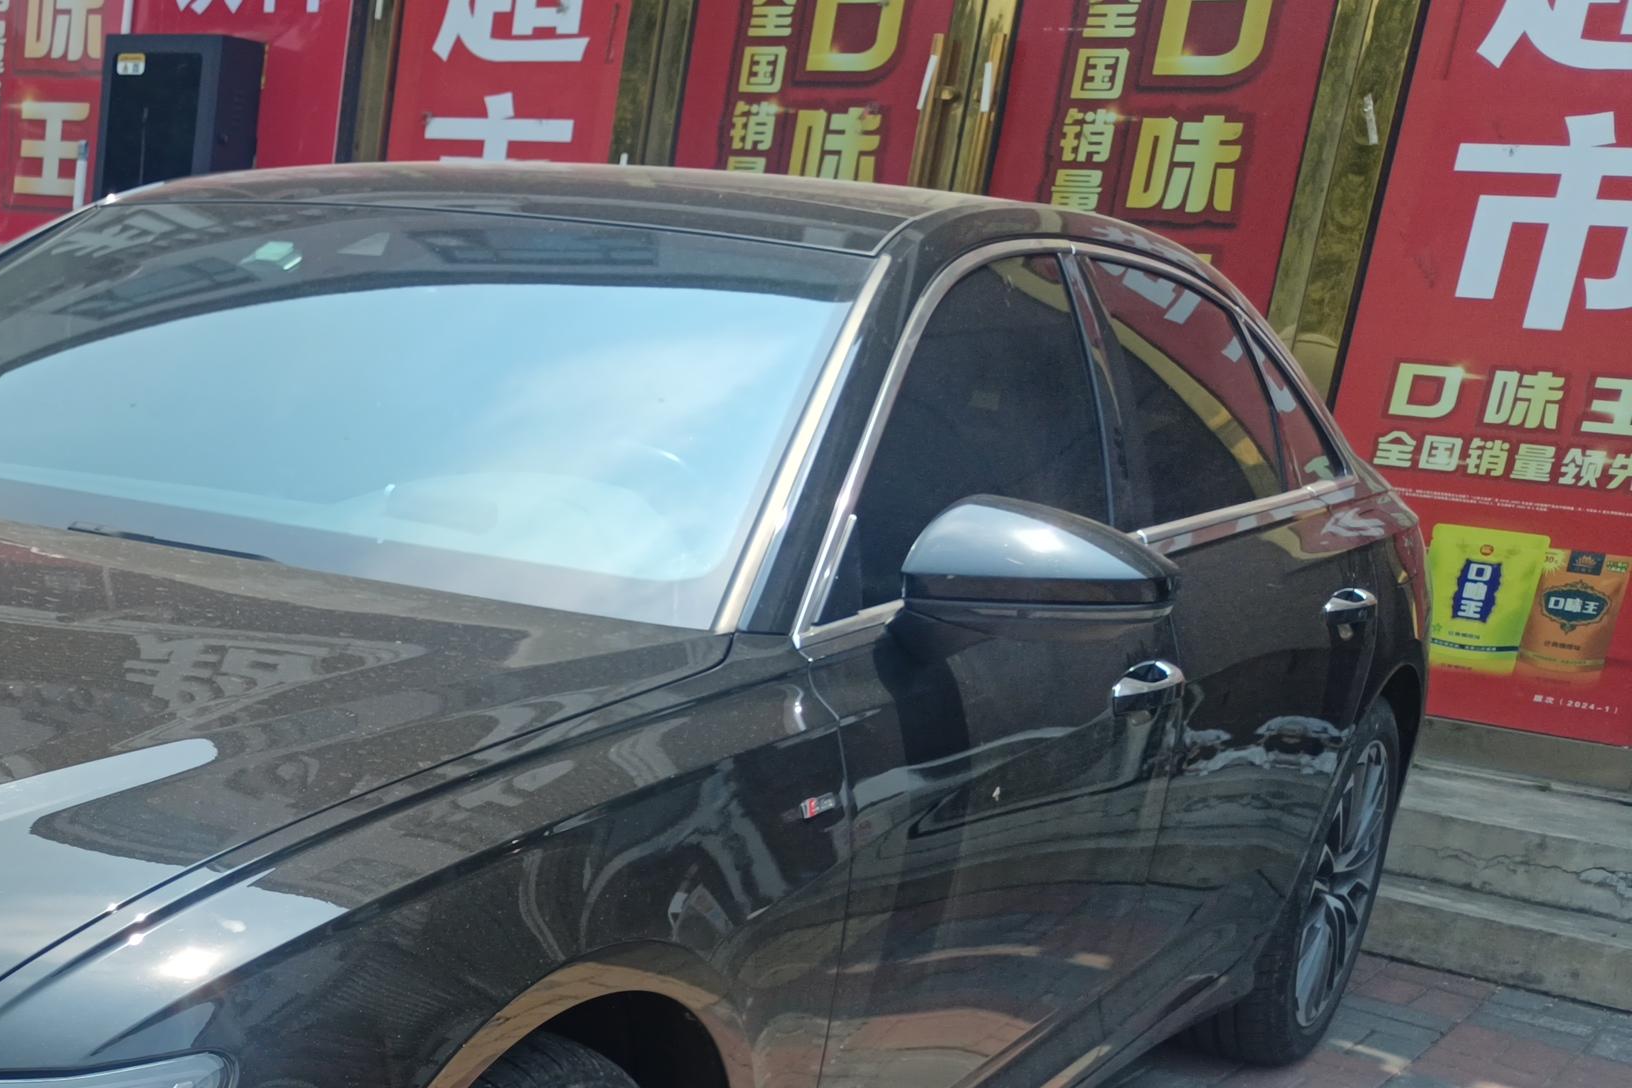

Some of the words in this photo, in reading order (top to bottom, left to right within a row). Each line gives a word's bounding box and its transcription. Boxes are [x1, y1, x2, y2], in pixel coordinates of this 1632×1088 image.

[1126, 0, 1271, 270] 口味
[1388, 362, 1632, 436] 口味王
[1372, 430, 1632, 491] 全国销量领先
[1457, 563, 1493, 619] 口味王
